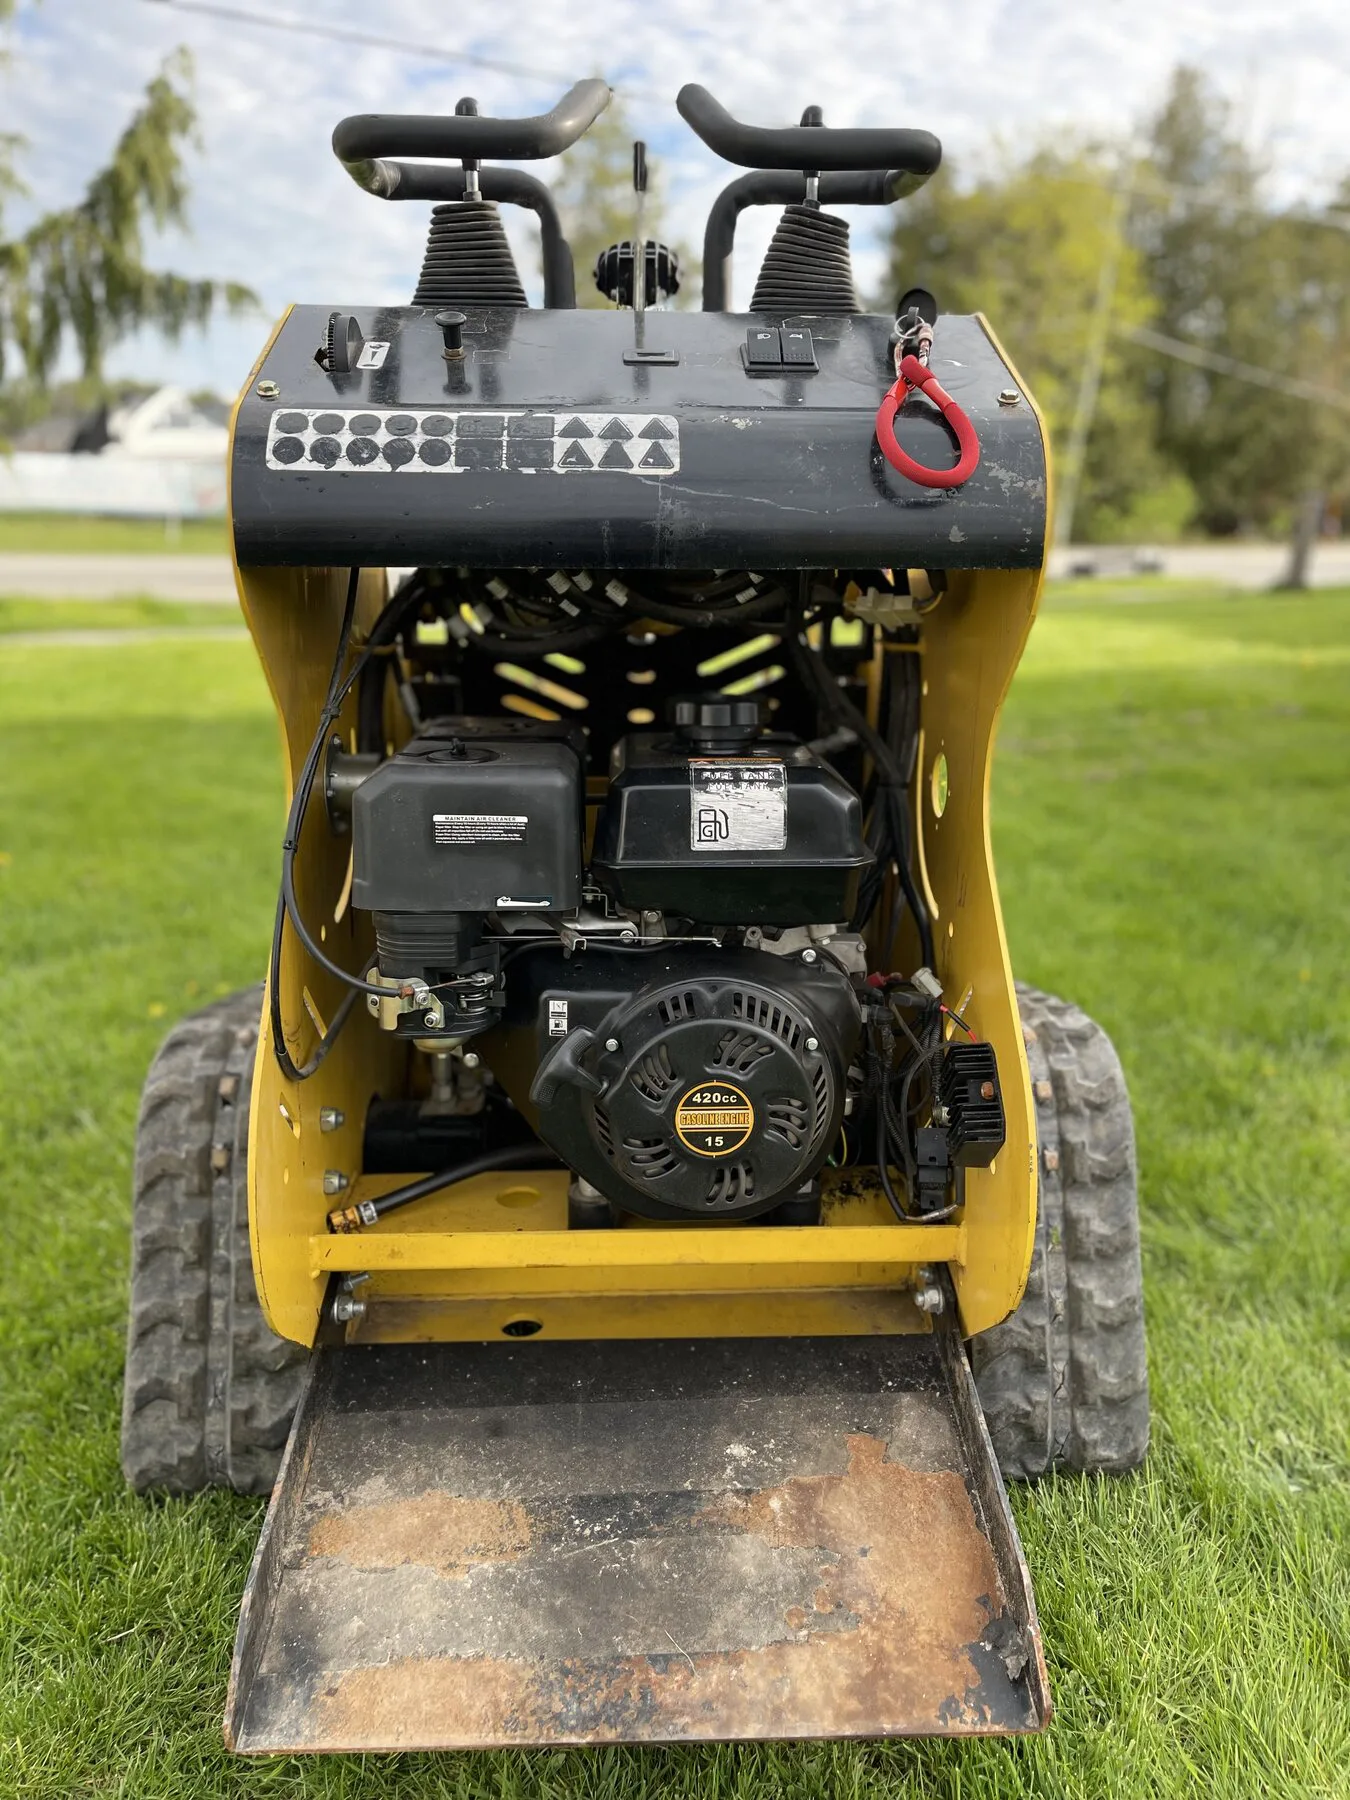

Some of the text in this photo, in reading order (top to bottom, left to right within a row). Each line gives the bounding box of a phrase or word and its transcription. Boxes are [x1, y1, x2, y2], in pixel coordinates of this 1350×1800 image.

[692, 1092, 737, 1103] 420cc
[680, 1112, 749, 1125] GASOLINE ENGINE
[705, 1136, 724, 1147] 15
